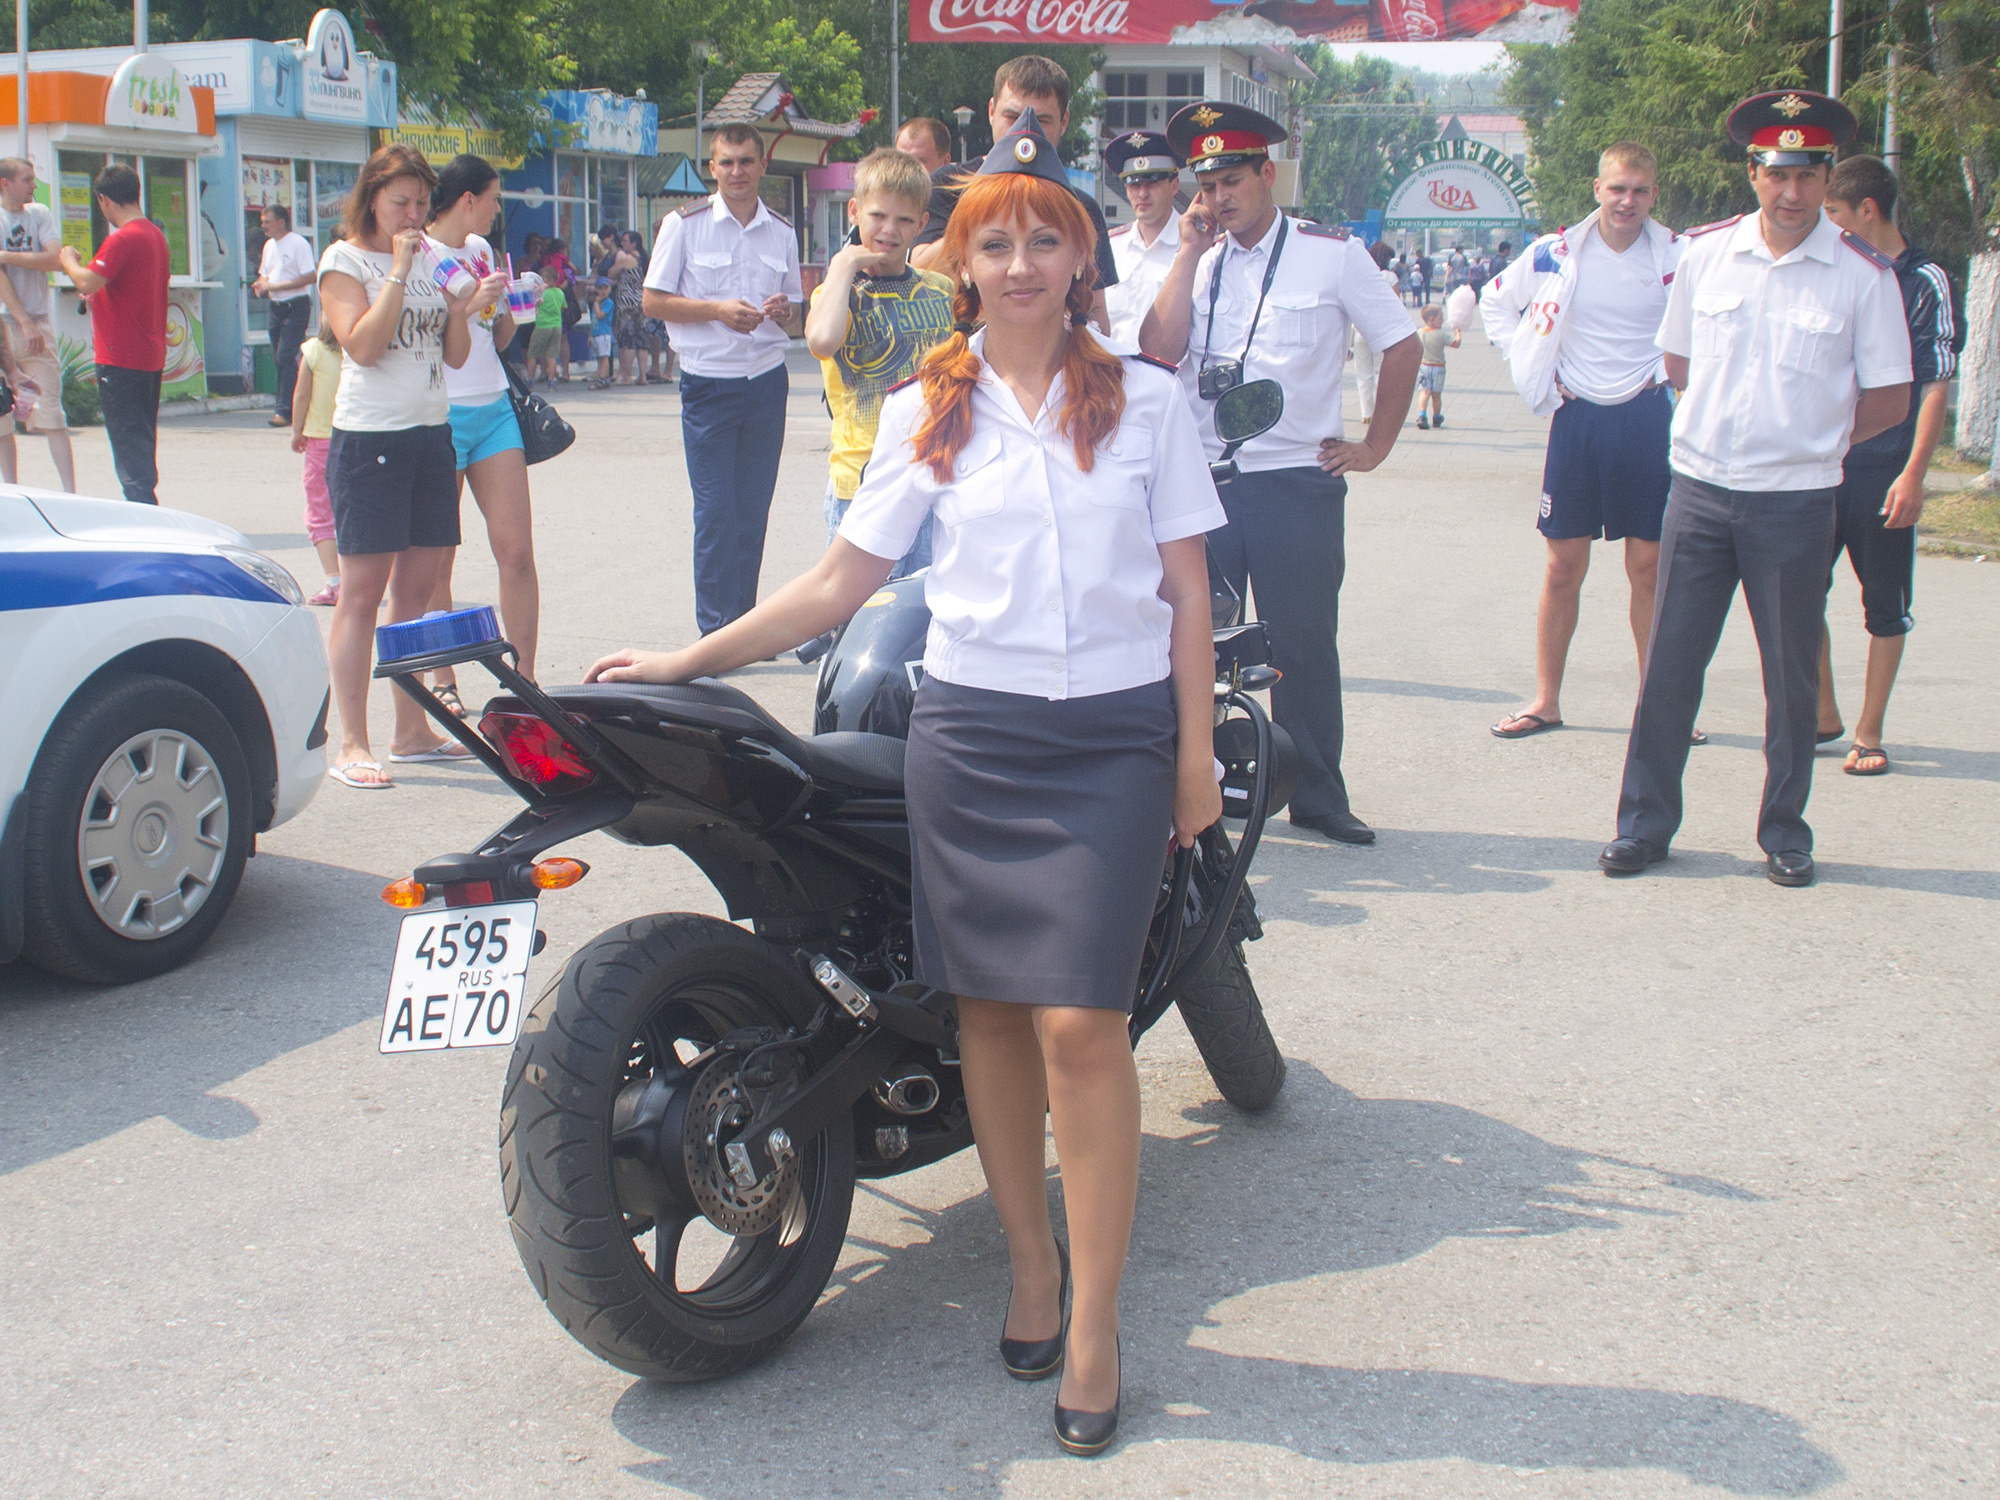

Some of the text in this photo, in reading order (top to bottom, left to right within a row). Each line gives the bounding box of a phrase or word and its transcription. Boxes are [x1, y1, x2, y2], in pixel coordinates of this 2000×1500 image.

[129, 64, 181, 108] fresh
[1418, 163, 1480, 178] Финансовое
[1481, 170, 1515, 213] Агентство
[1427, 179, 1480, 211] ТФА
[1387, 219, 1399, 228] От
[1430, 220, 1442, 229] до
[1444, 220, 1478, 229] покупки
[1480, 220, 1502, 229] один
[1503, 220, 1520, 228] шаг
[415, 917, 512, 971] 4595
[458, 969, 493, 989] RUS
[388, 989, 510, 1044] AE 70
